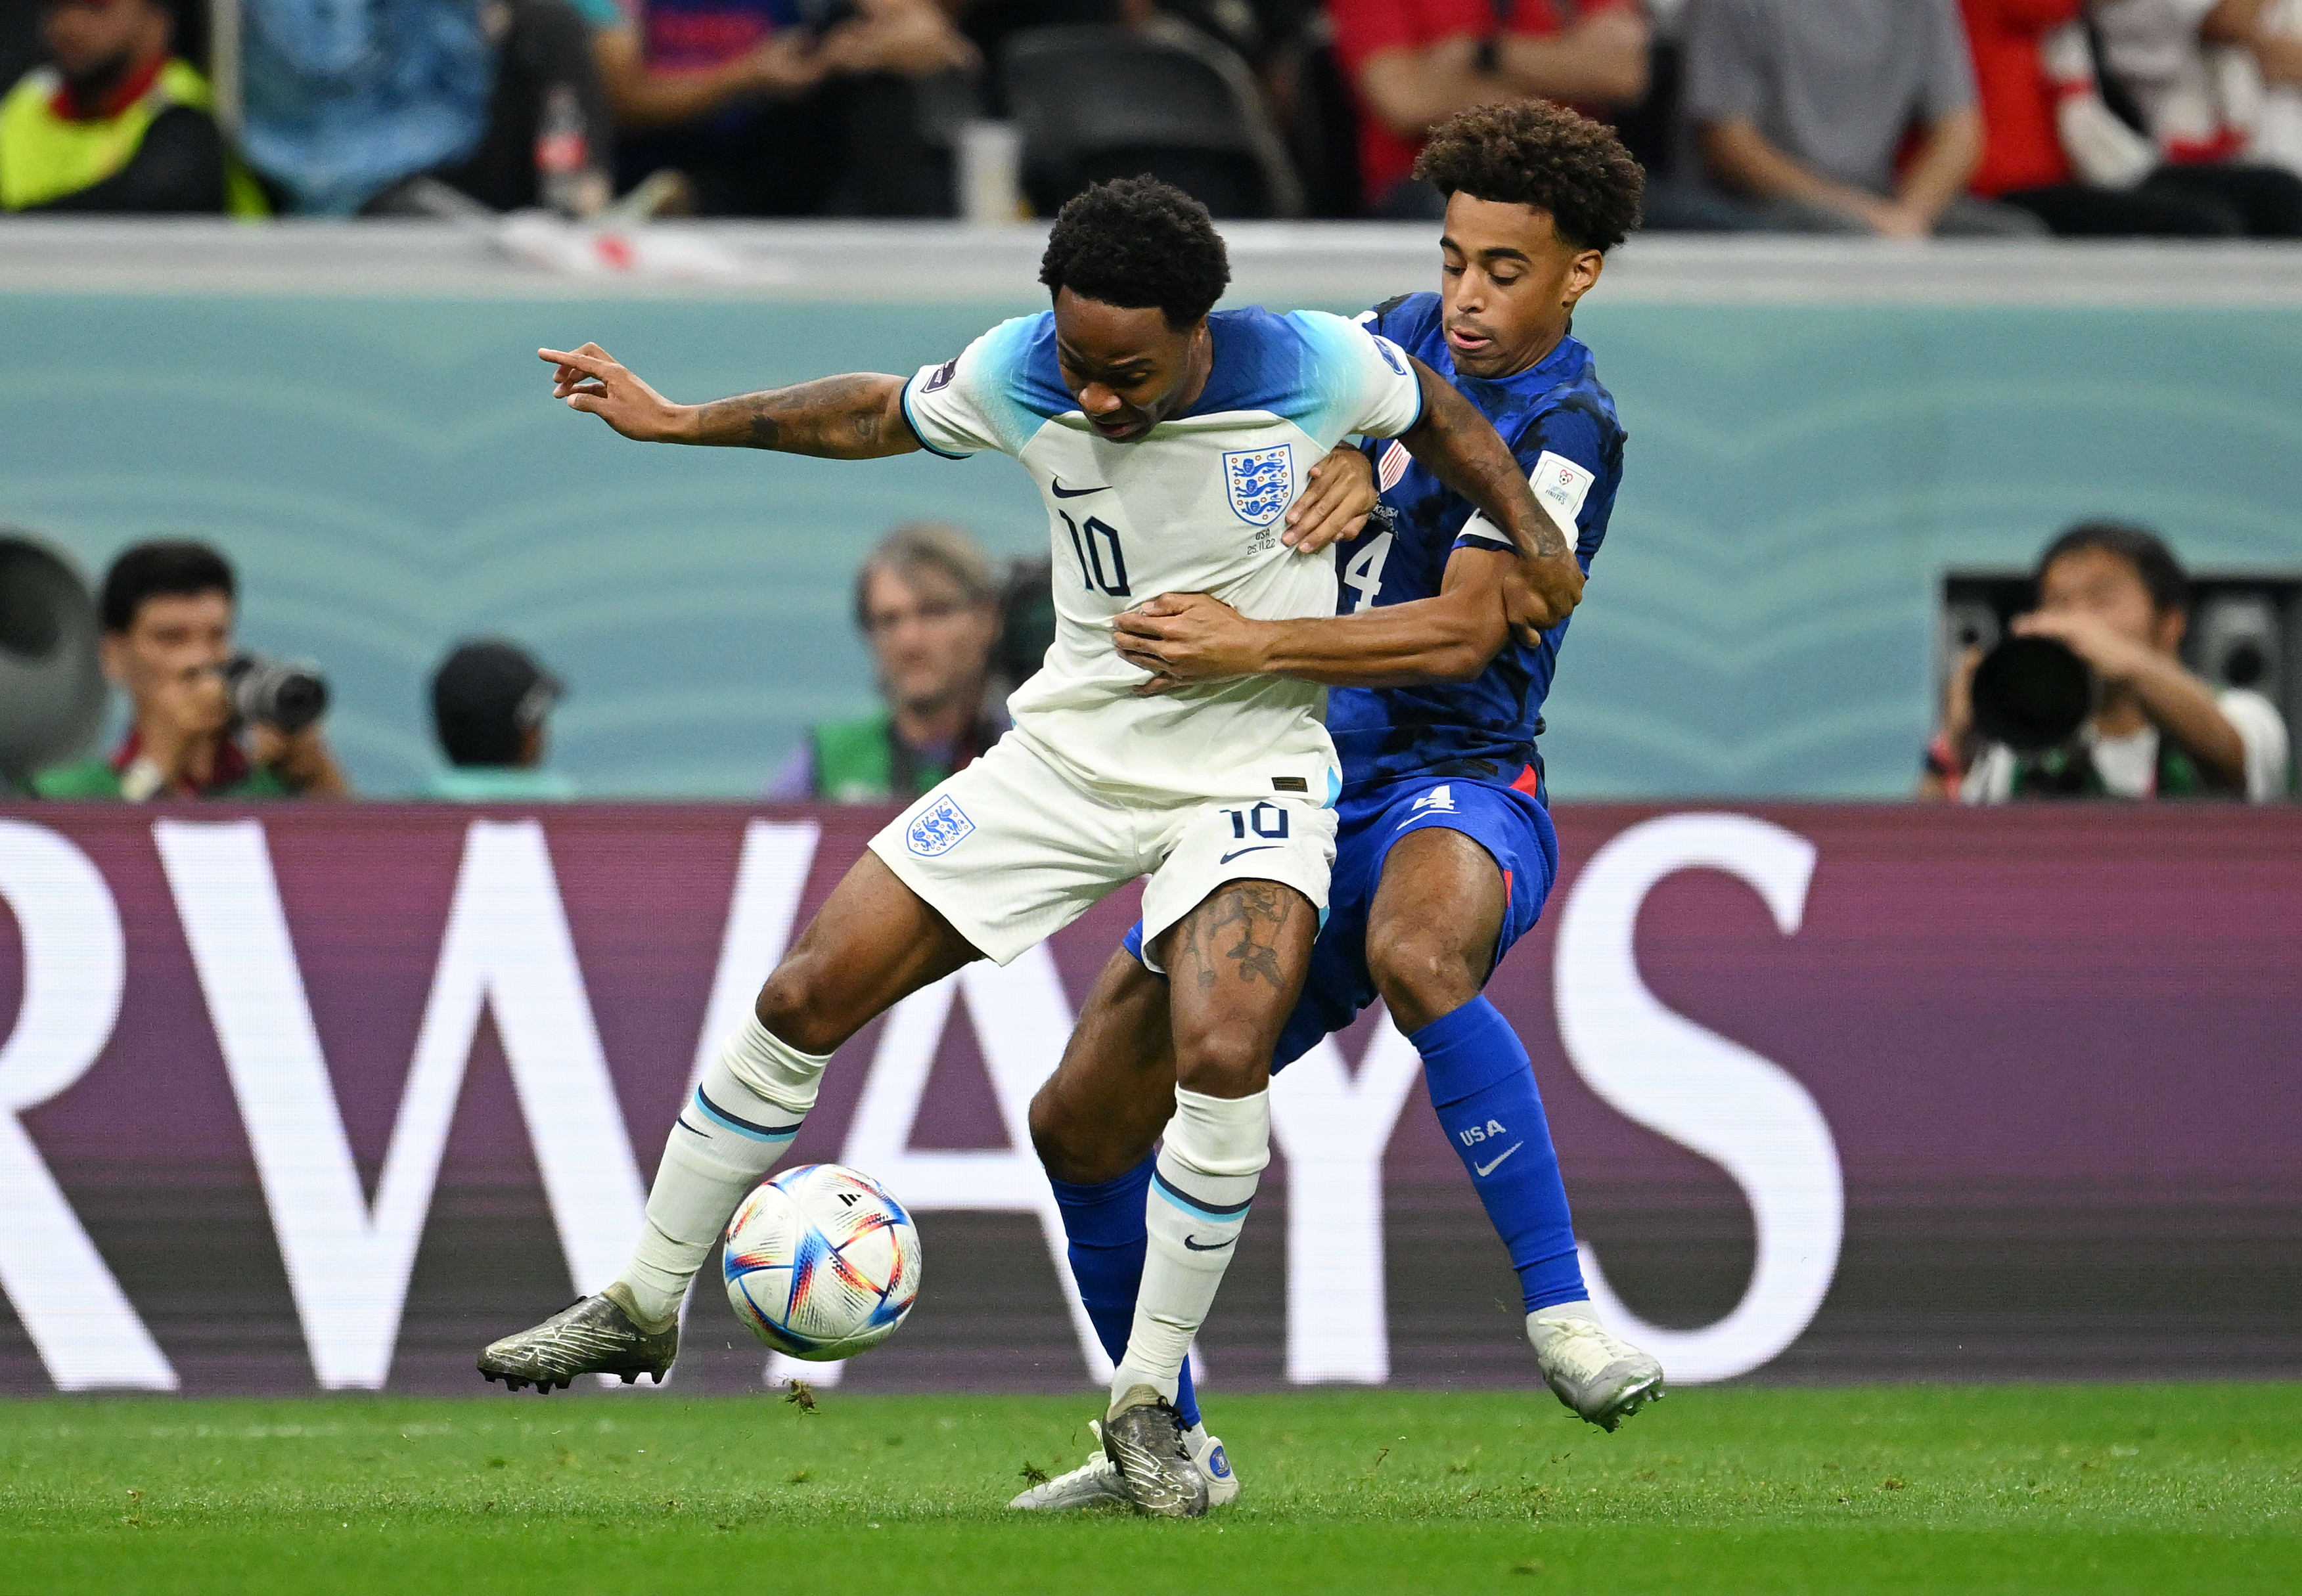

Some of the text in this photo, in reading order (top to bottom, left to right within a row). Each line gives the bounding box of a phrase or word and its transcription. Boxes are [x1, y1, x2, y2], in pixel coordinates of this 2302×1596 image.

[1255, 528, 1271, 541] USA
[1058, 508, 1131, 596] 10
[1343, 531, 1393, 615] 4
[1411, 784, 1455, 810] 4
[1219, 801, 1289, 839] 10
[1459, 1119, 1506, 1147] USA
